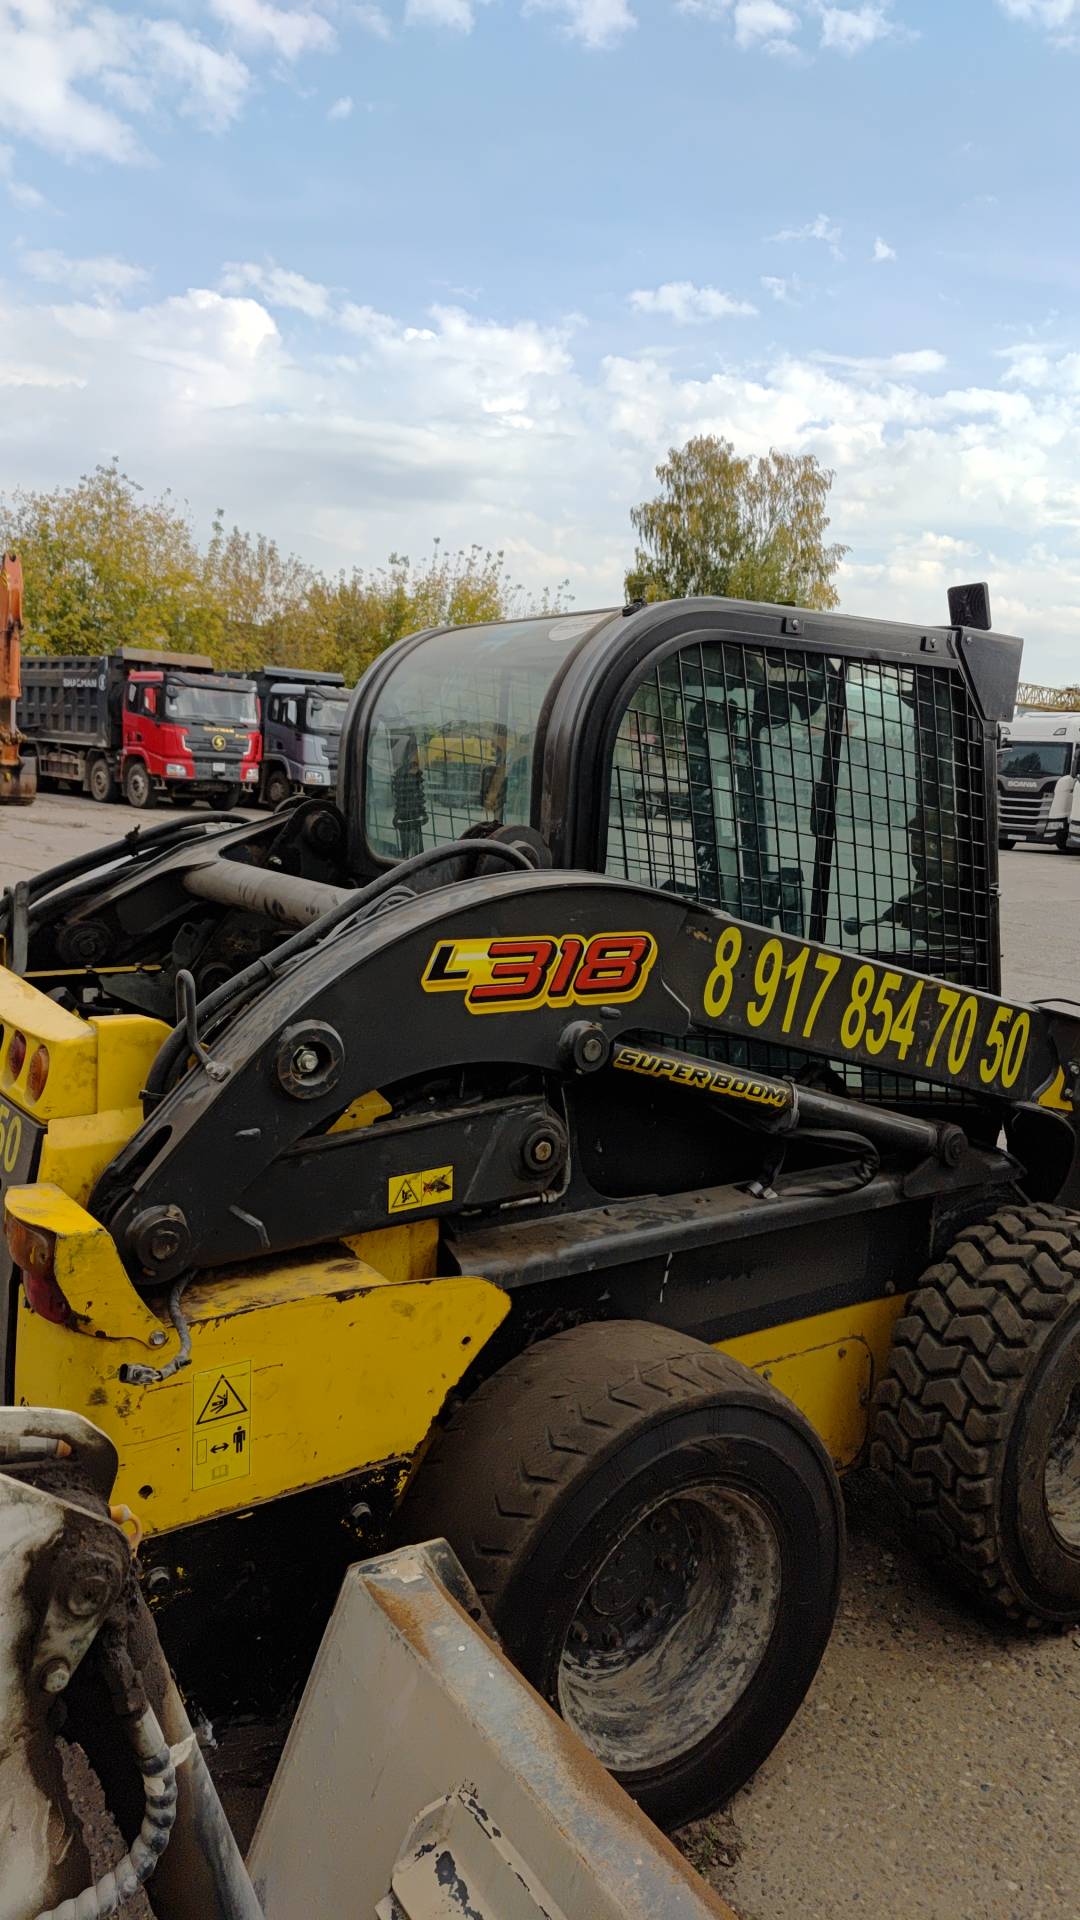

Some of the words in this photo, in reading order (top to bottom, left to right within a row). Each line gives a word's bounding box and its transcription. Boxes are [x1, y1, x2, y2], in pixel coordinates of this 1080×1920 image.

[703, 925, 742, 1018] 8
[747, 938, 841, 1038] 917
[840, 964, 924, 1060] 854
[925, 986, 978, 1075] 70
[979, 1005, 1030, 1088] 50
[614, 1049, 711, 1087] SUPER
[710, 1072, 787, 1107] BOOM
